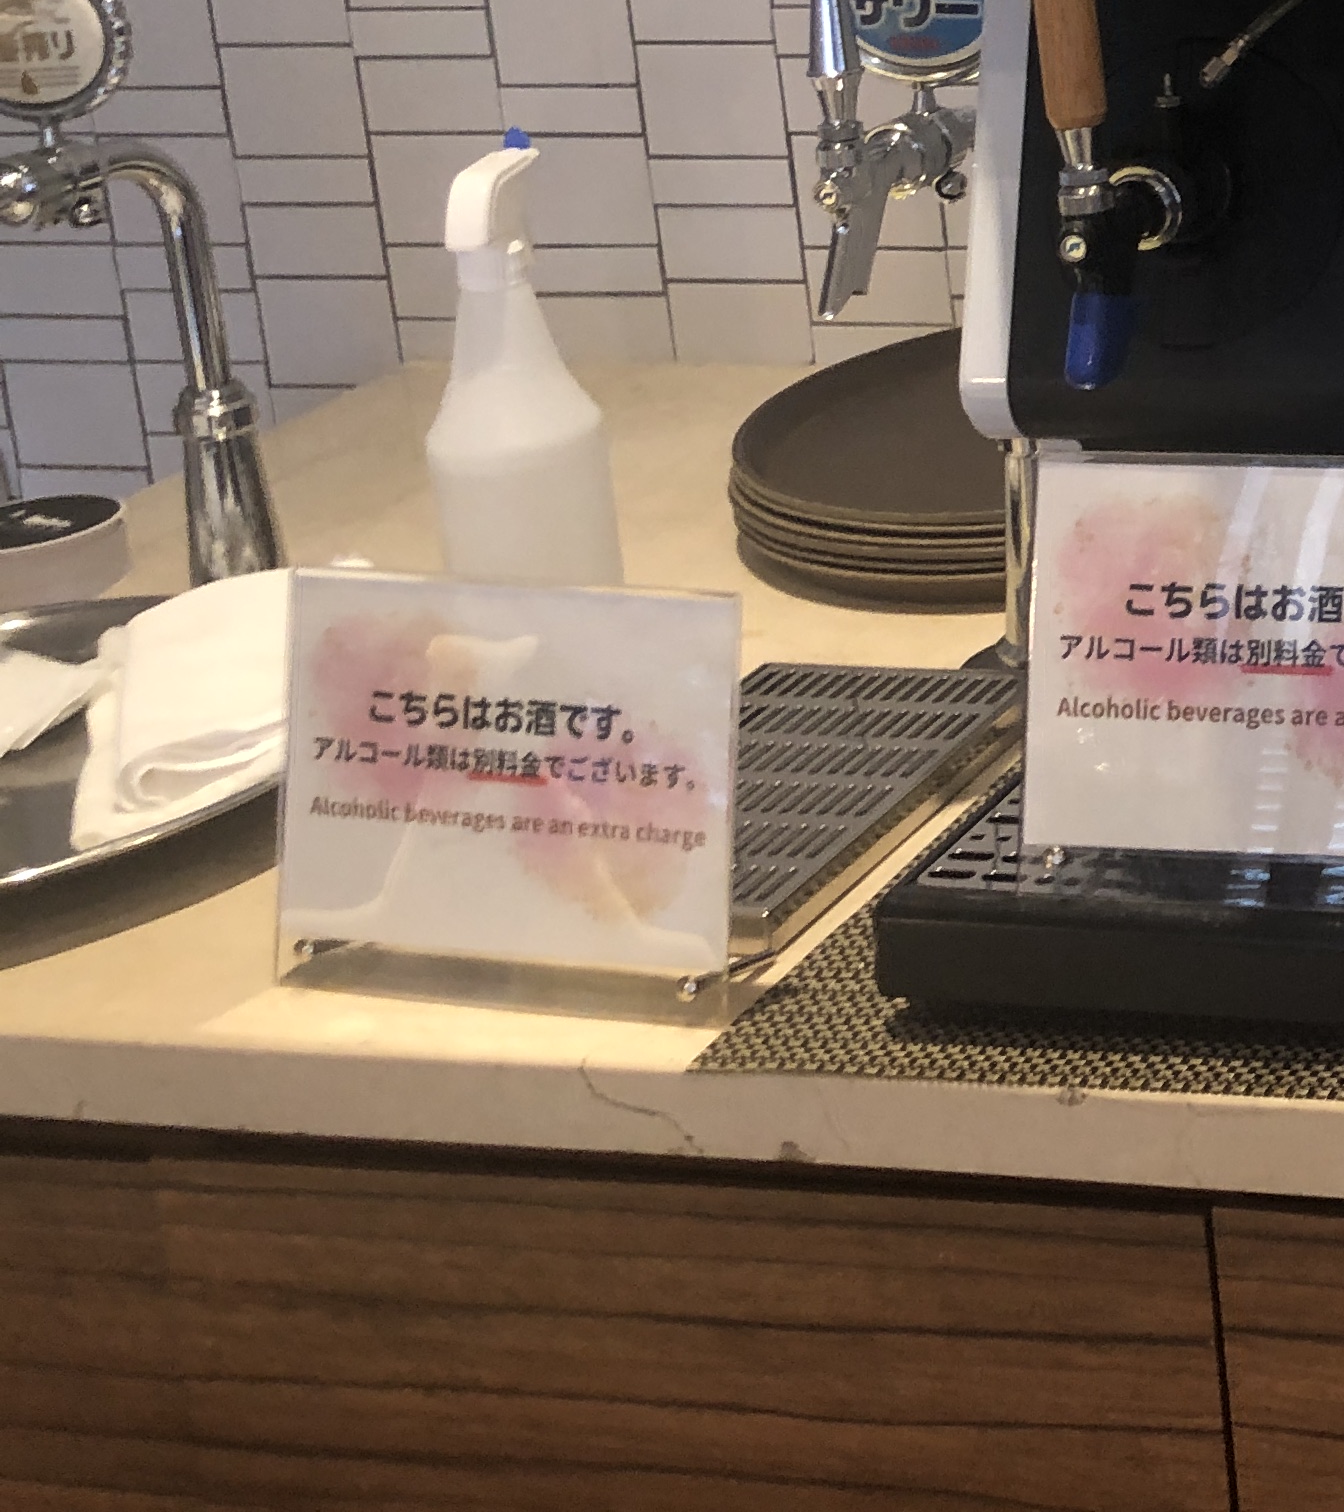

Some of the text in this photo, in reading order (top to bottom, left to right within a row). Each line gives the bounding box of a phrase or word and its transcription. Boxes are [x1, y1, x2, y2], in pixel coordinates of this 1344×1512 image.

[369, 690, 635, 744] こちらはお酒です。
[1057, 696, 1161, 721] Alcoholic
[1167, 700, 1285, 730] beverages
[1291, 708, 1328, 727] are
[314, 736, 695, 791] アルコール類は別料金でございます。
[310, 796, 707, 851] Alcoholic beverages are an extra charge
